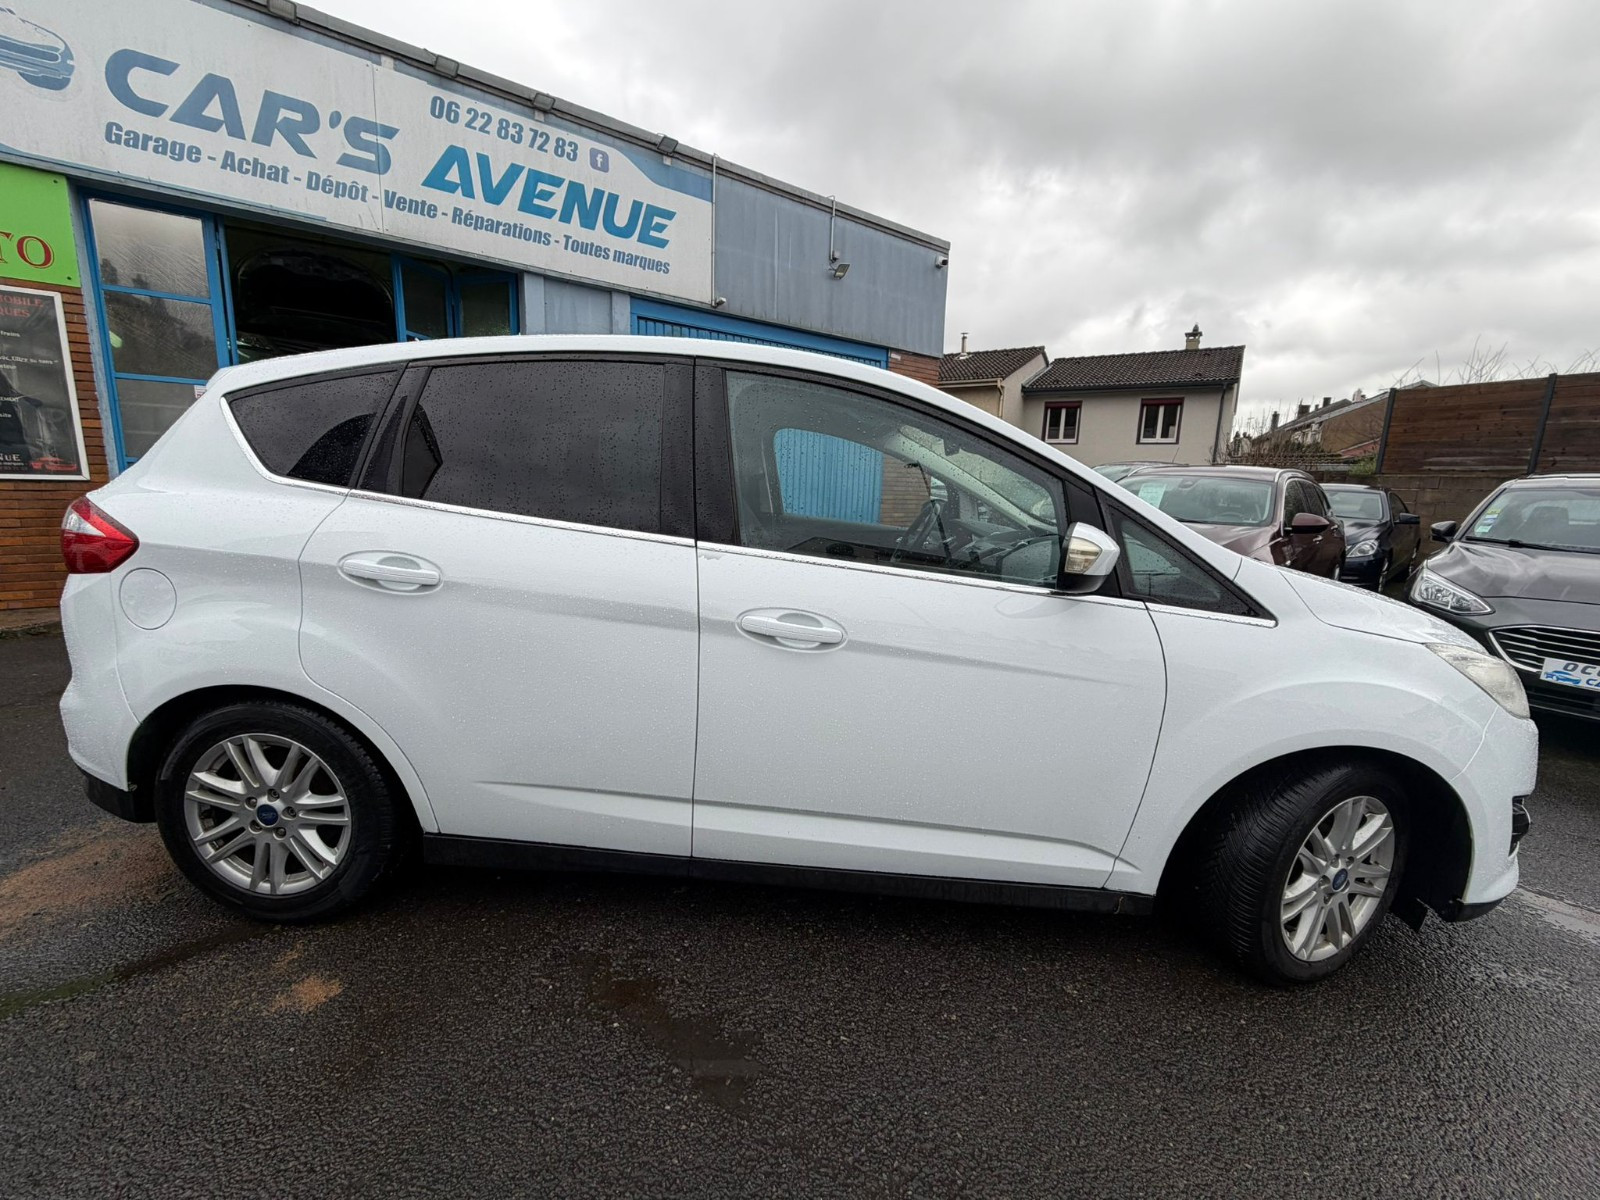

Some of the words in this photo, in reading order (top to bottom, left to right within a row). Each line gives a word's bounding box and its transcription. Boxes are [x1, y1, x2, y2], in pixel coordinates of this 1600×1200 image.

[105, 48, 400, 175] CAR'S
[421, 144, 677, 249] AVENUE
[429, 96, 460, 125] 06
[464, 107, 493, 135] 22
[496, 118, 523, 145] 83
[528, 127, 551, 153] 72
[553, 137, 579, 162] 83
[104, 121, 201, 164] Garage
[220, 150, 289, 185] Achat
[306, 171, 369, 203] Dépôt
[384, 189, 438, 219] Vente
[452, 206, 552, 246] Réparations
[563, 235, 611, 261] Toutes
[613, 248, 671, 275] marques
[1563, 662, 1600, 677] OC
